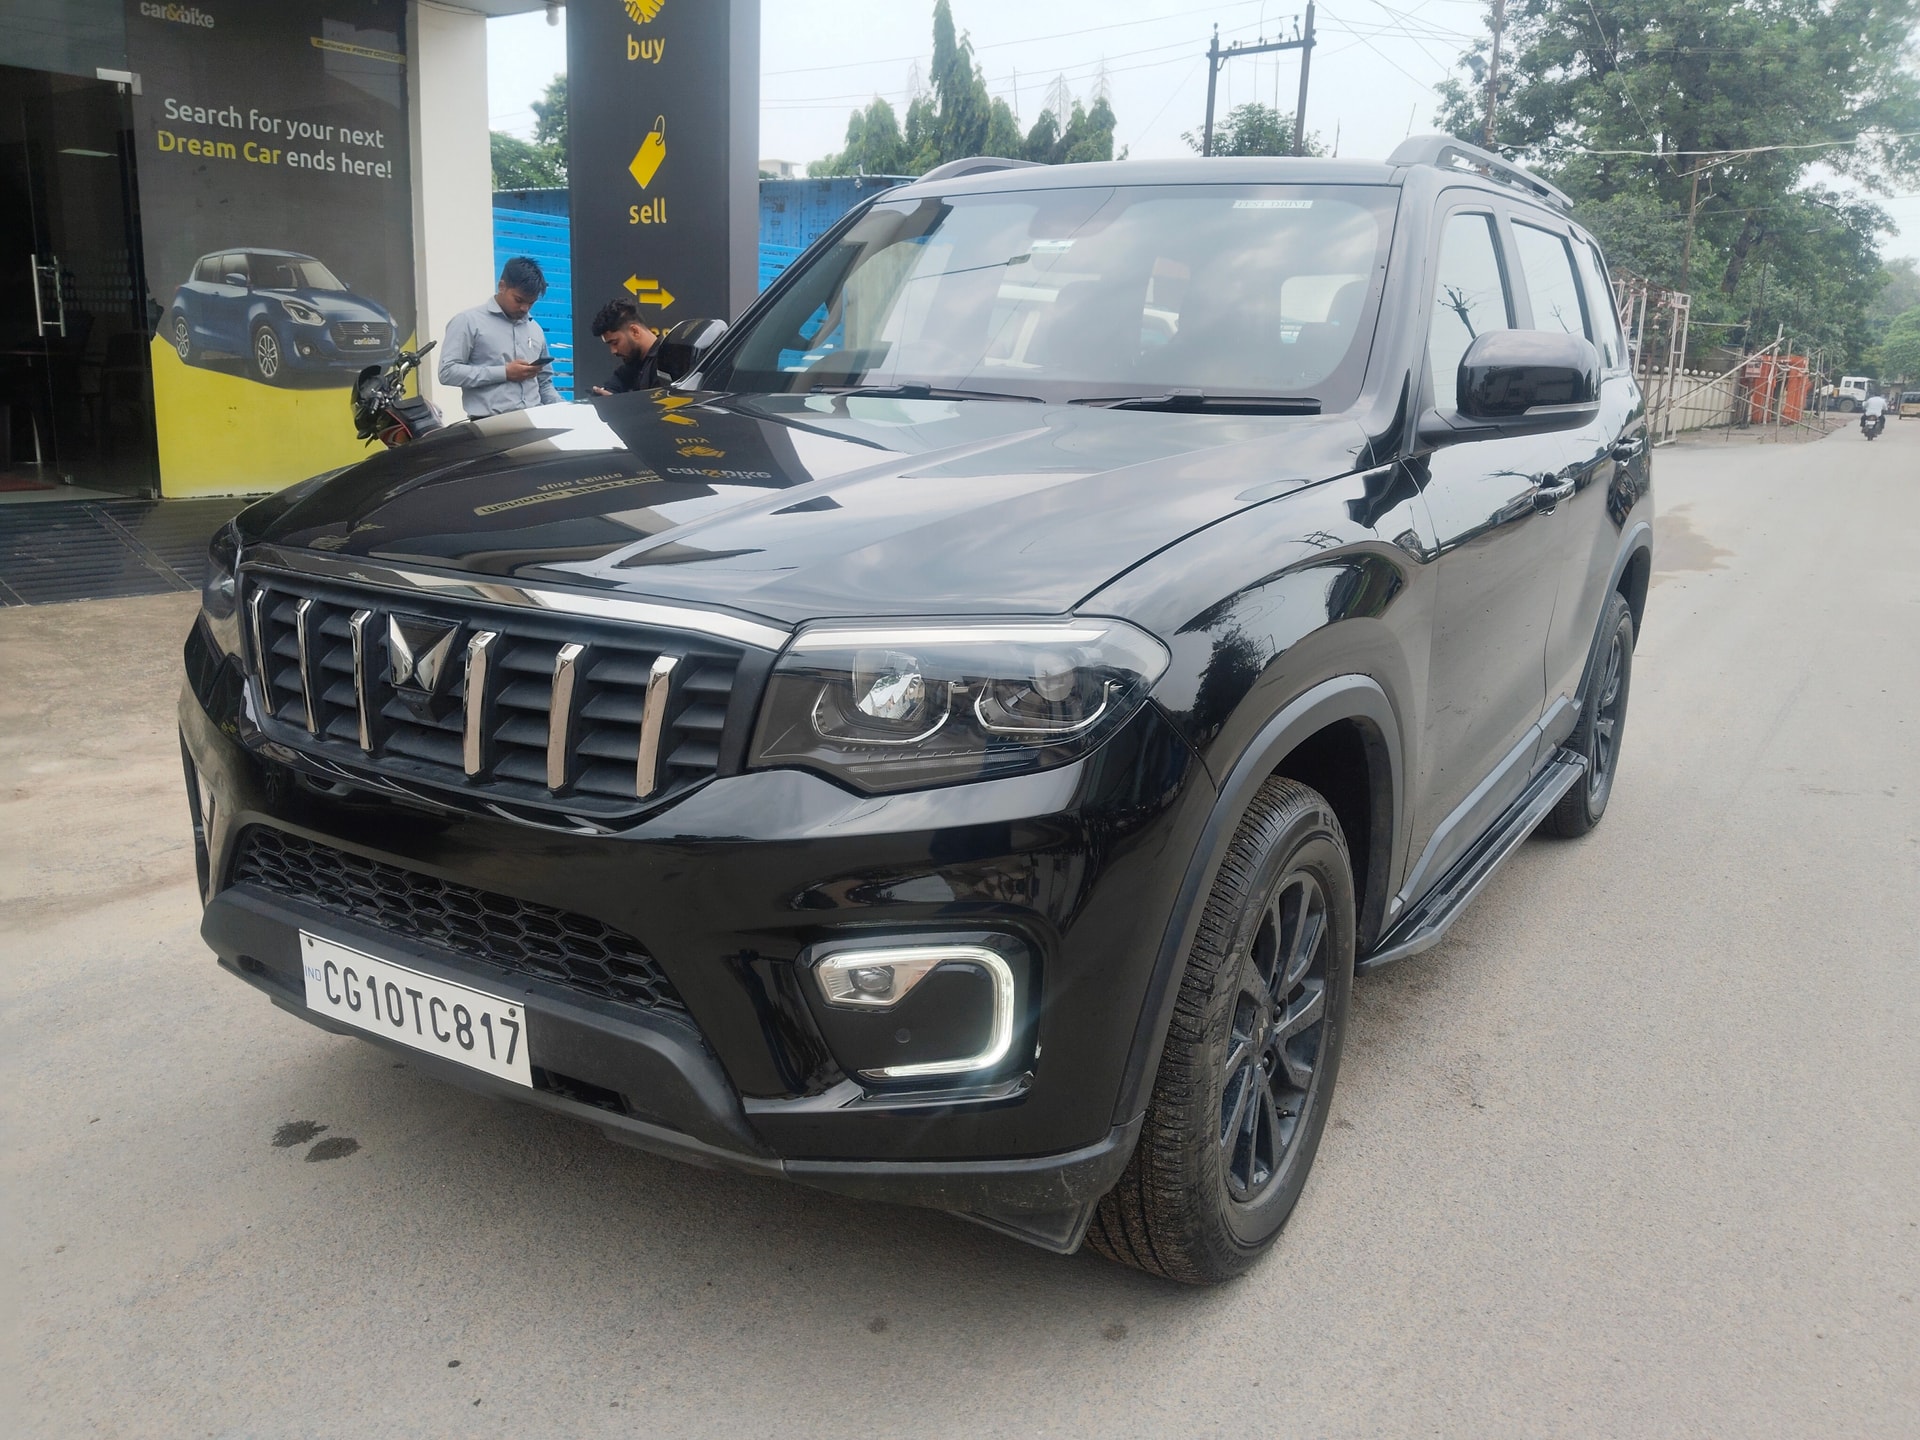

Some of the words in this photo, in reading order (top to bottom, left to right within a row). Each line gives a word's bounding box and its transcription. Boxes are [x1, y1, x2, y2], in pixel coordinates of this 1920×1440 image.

[140, 2, 215, 28] car&bike
[627, 34, 666, 64] buy
[165, 98, 243, 130] Search
[249, 109, 282, 134] for
[286, 118, 334, 142] your
[339, 127, 385, 149] next
[157, 130, 237, 160] Dream
[243, 141, 282, 165] Car
[286, 150, 336, 172] ends
[341, 155, 393, 179] here!
[629, 197, 667, 224] sell
[305, 965, 321, 982] IND
[323, 960, 520, 1065] CG10TC817
